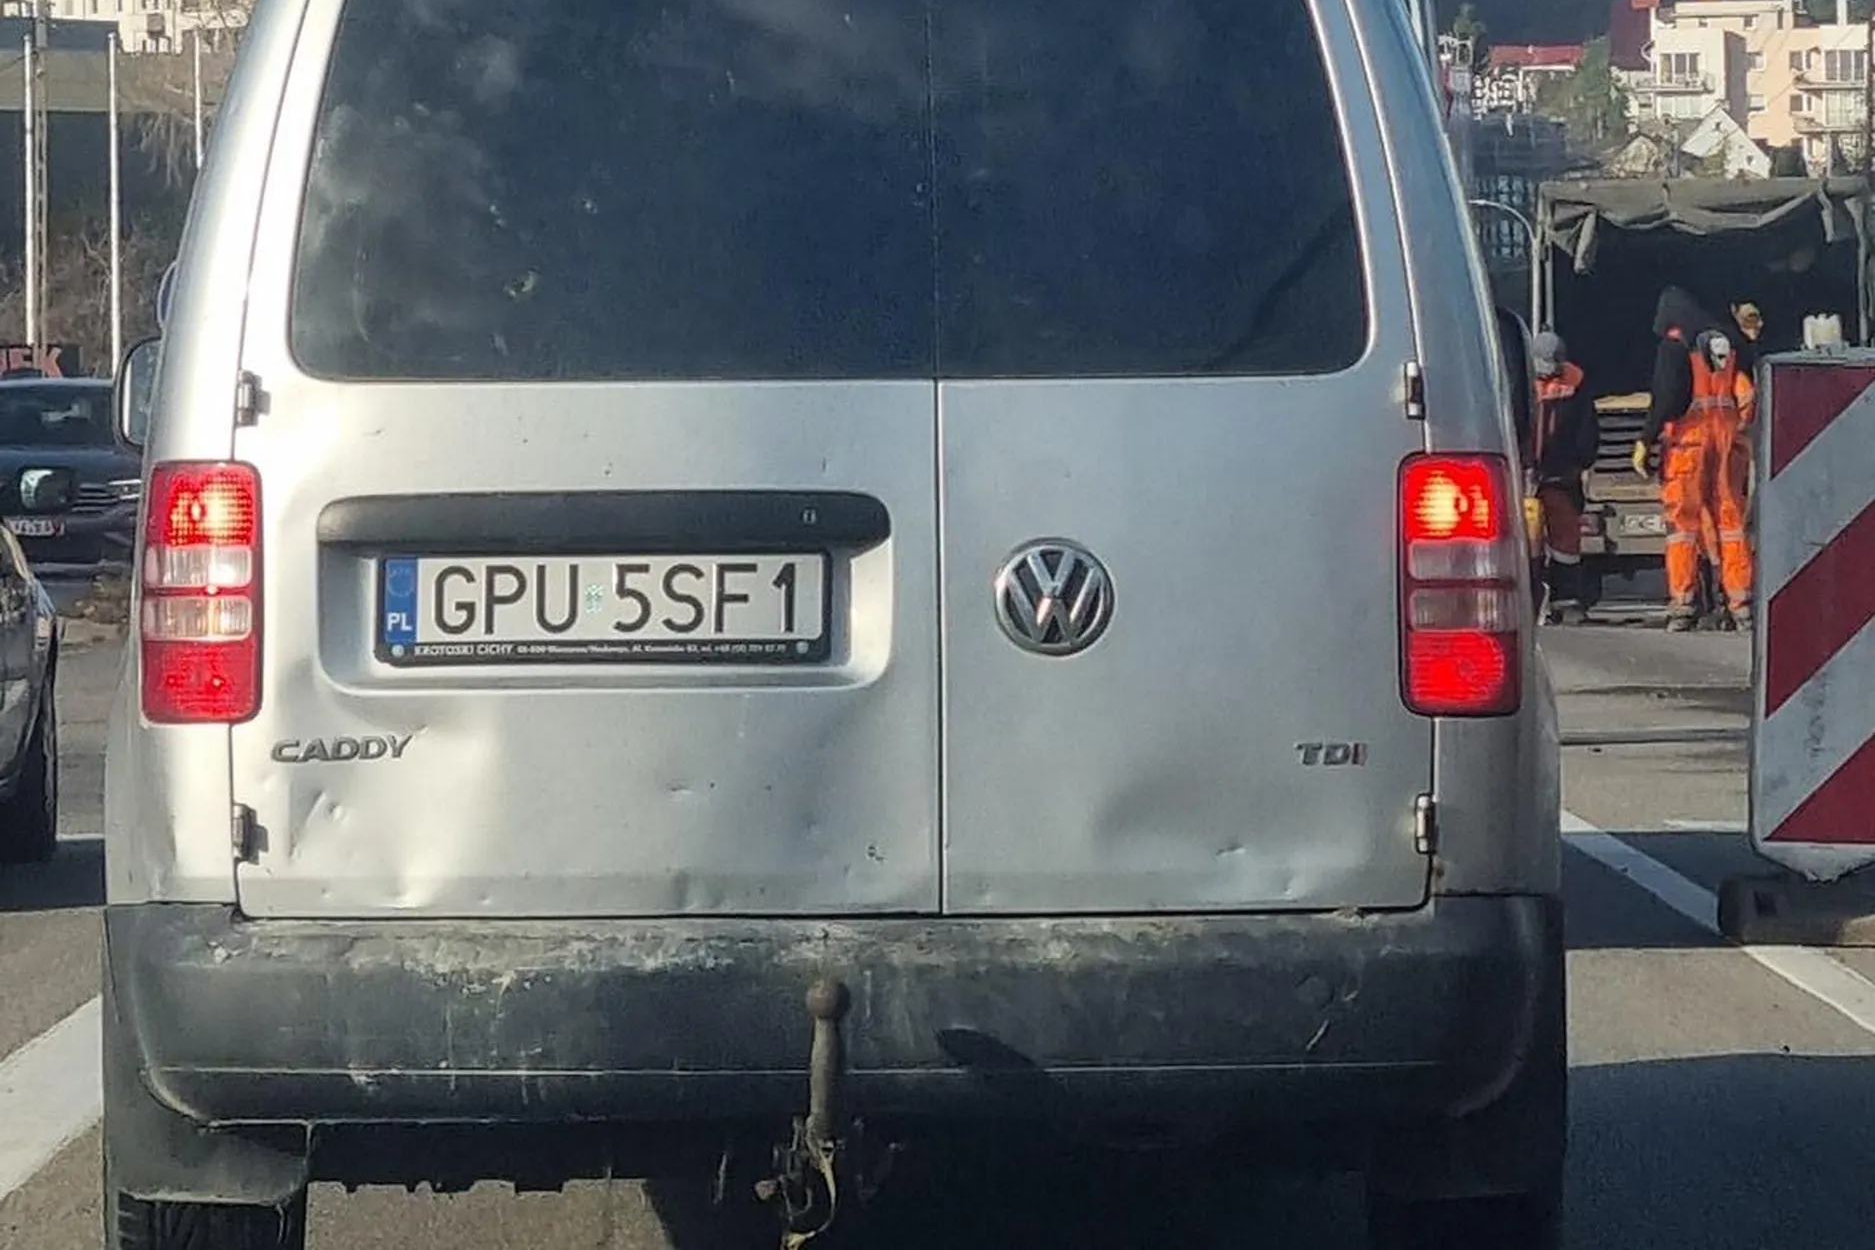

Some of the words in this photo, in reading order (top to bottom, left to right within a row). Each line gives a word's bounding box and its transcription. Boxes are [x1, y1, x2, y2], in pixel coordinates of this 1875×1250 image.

[433, 563, 579, 635] GPU
[612, 562, 797, 634] 5SF1
[386, 612, 413, 631] PL
[270, 733, 413, 763] CADDY
[1296, 742, 1368, 766] TDI
